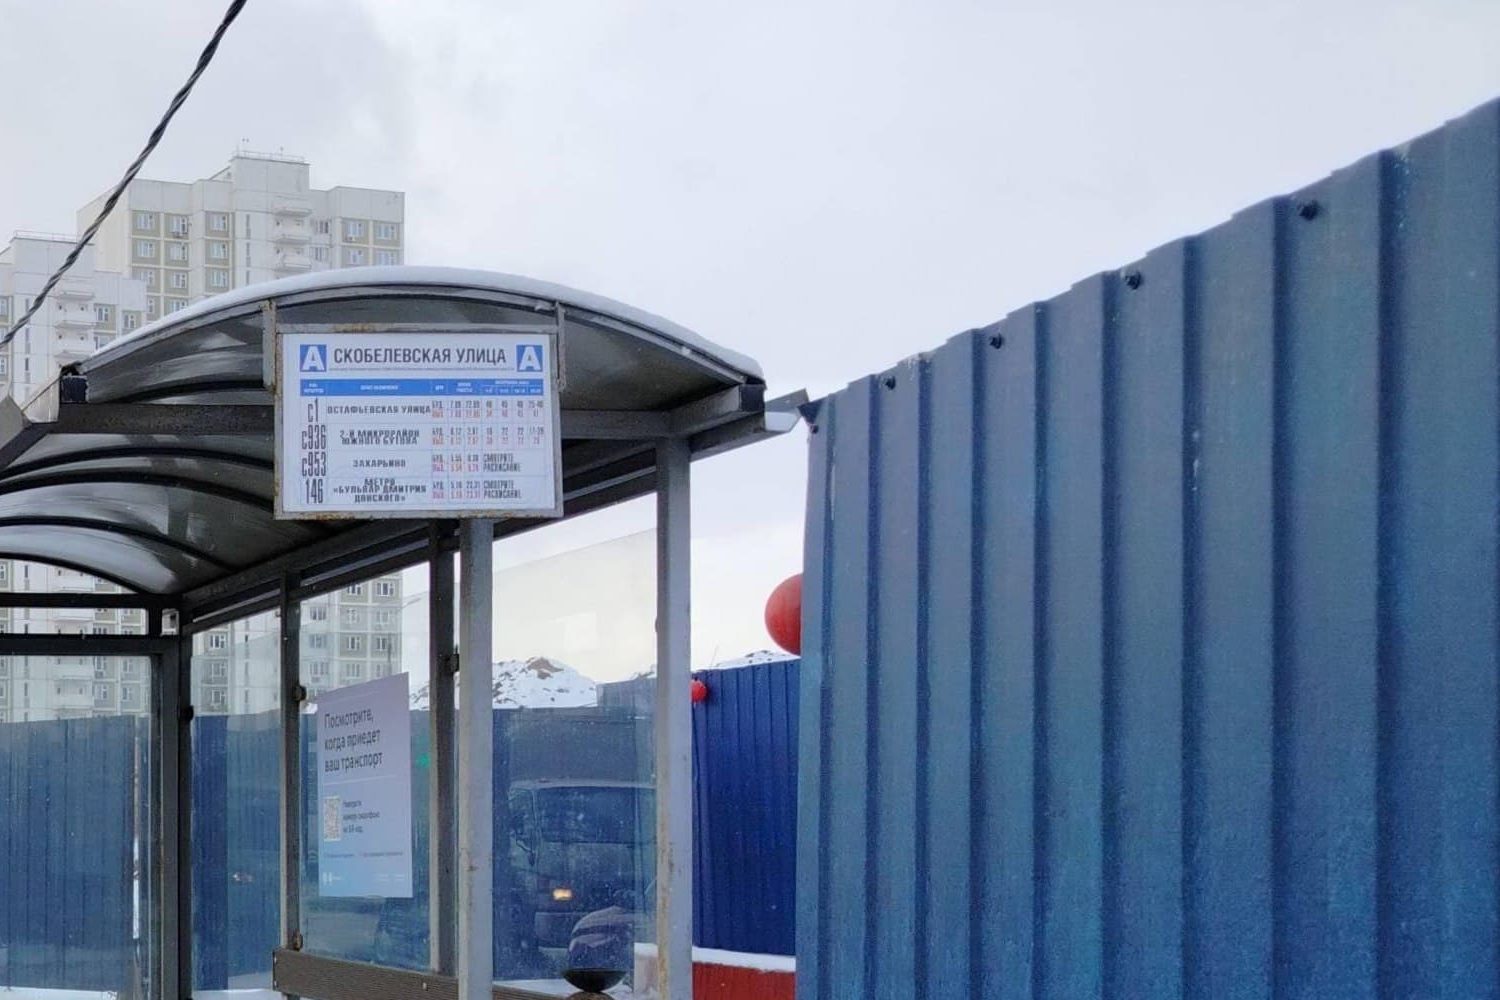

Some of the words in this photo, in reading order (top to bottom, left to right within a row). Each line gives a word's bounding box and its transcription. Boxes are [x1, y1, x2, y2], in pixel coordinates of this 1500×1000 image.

[333, 348, 451, 364] СКОБЕЛЕВСКАЯ
[456, 348, 506, 365] УЛИЦА
[327, 405, 399, 415] ОСТАФЬЕВСКАЯ
[401, 405, 432, 415] УЛИЦА
[301, 424, 327, 450] с936
[301, 451, 327, 477] с953
[353, 459, 407, 468] ЗАХАРЬИНО
[305, 478, 324, 504] 146
[363, 478, 396, 487] МЕТРО
[382, 485, 427, 494] ДМИТРИЯ
[324, 709, 374, 729] Посмотрите,
[324, 736, 346, 751] когда
[347, 729, 381, 750] приедет
[324, 759, 340, 772] ваш
[340, 752, 383, 774] транспорт
